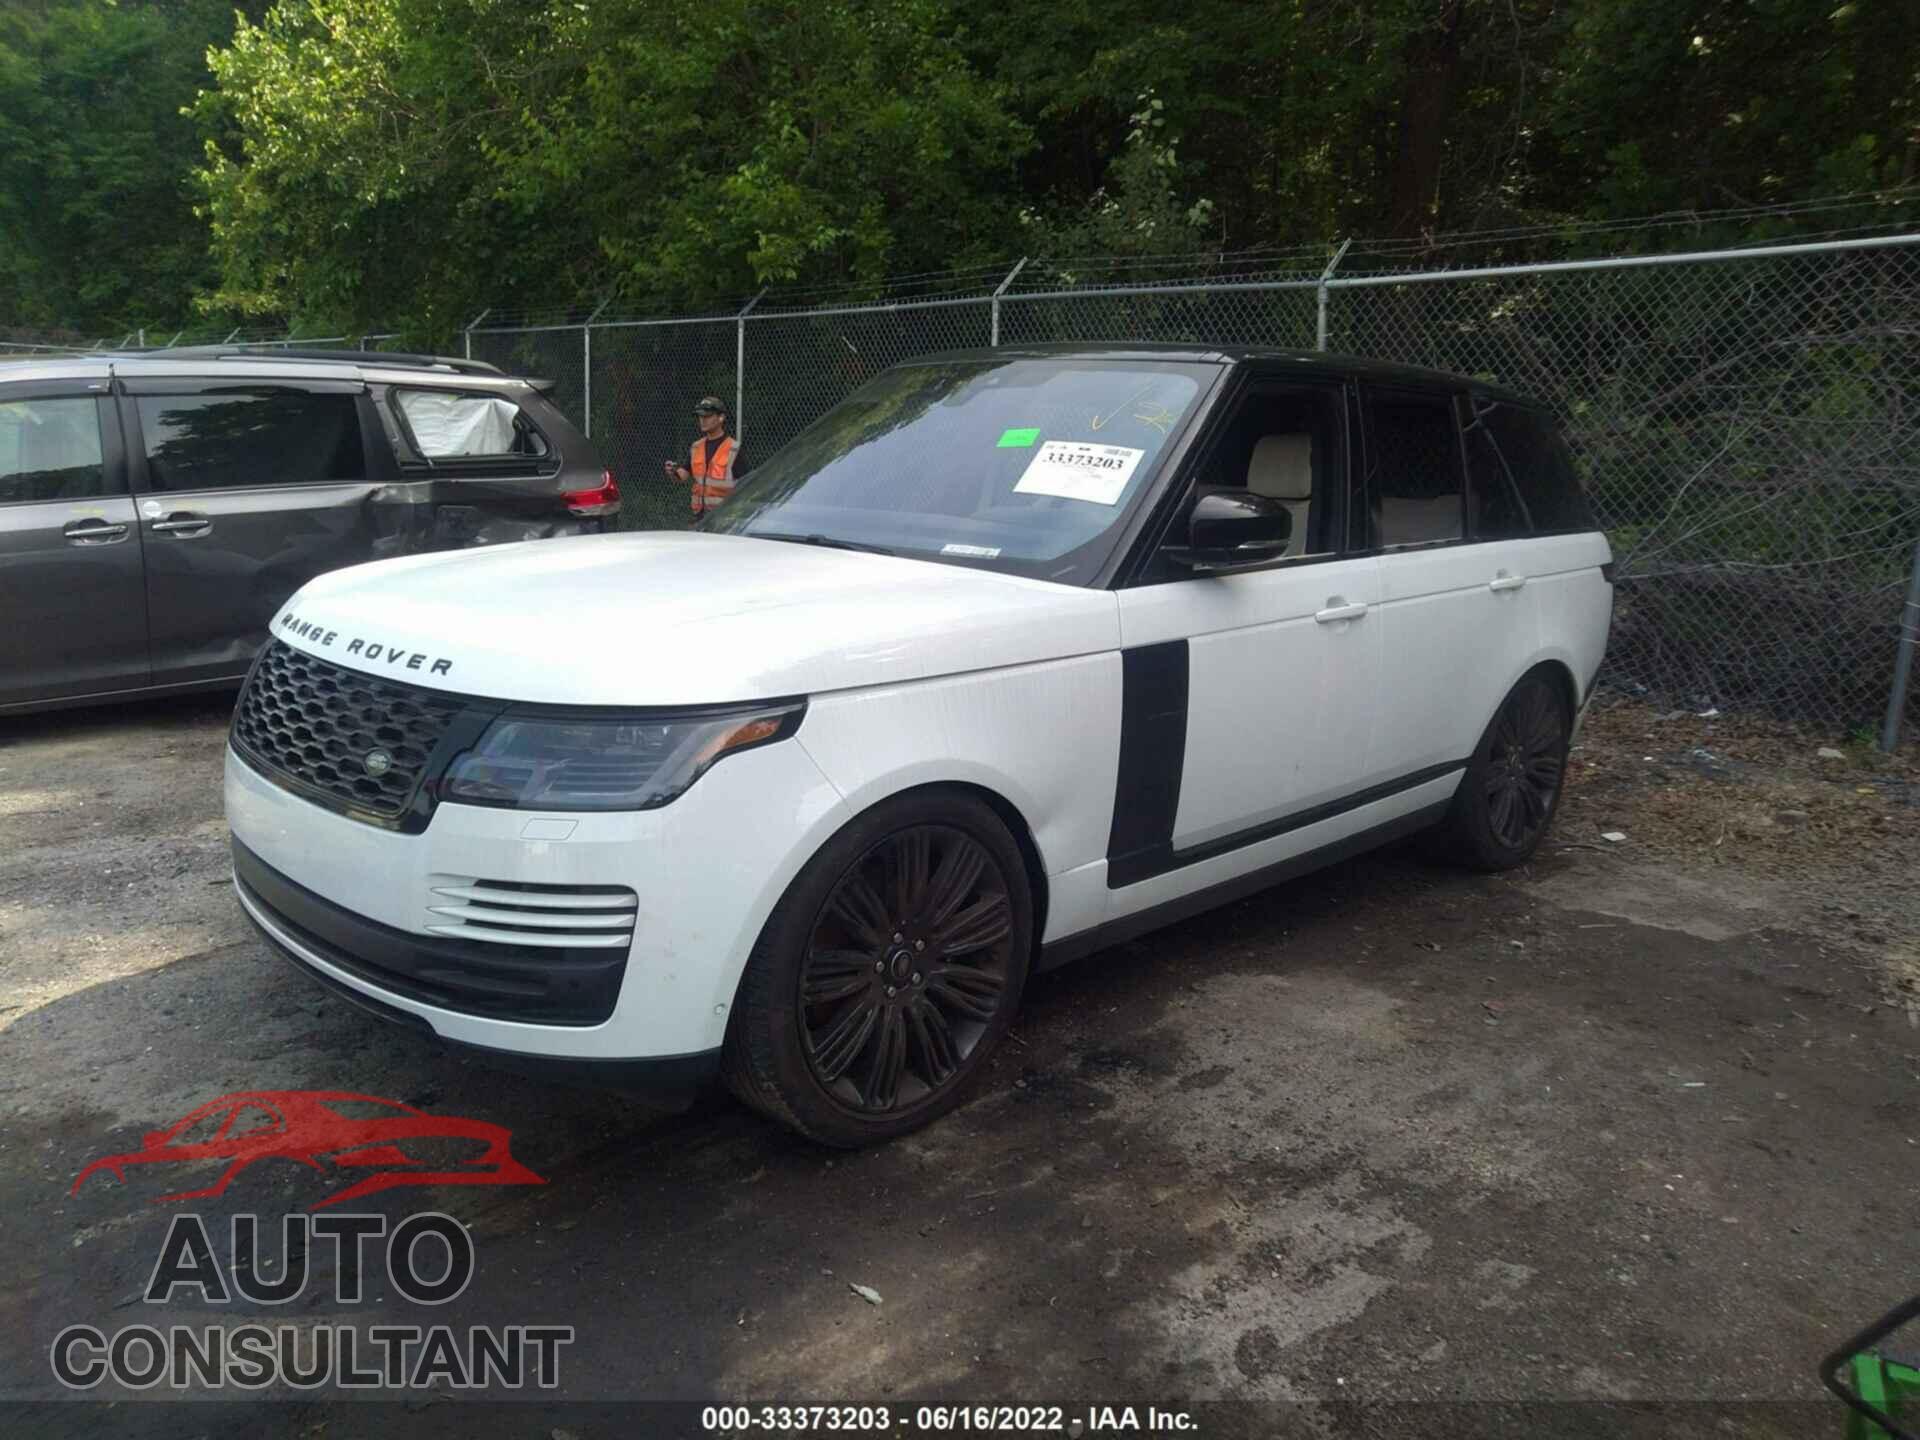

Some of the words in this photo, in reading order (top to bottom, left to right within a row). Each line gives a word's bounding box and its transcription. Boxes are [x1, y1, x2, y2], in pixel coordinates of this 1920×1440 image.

[1042, 452, 1124, 470] 33373203
[281, 612, 338, 646] RANGE
[347, 637, 453, 675] ROVER
